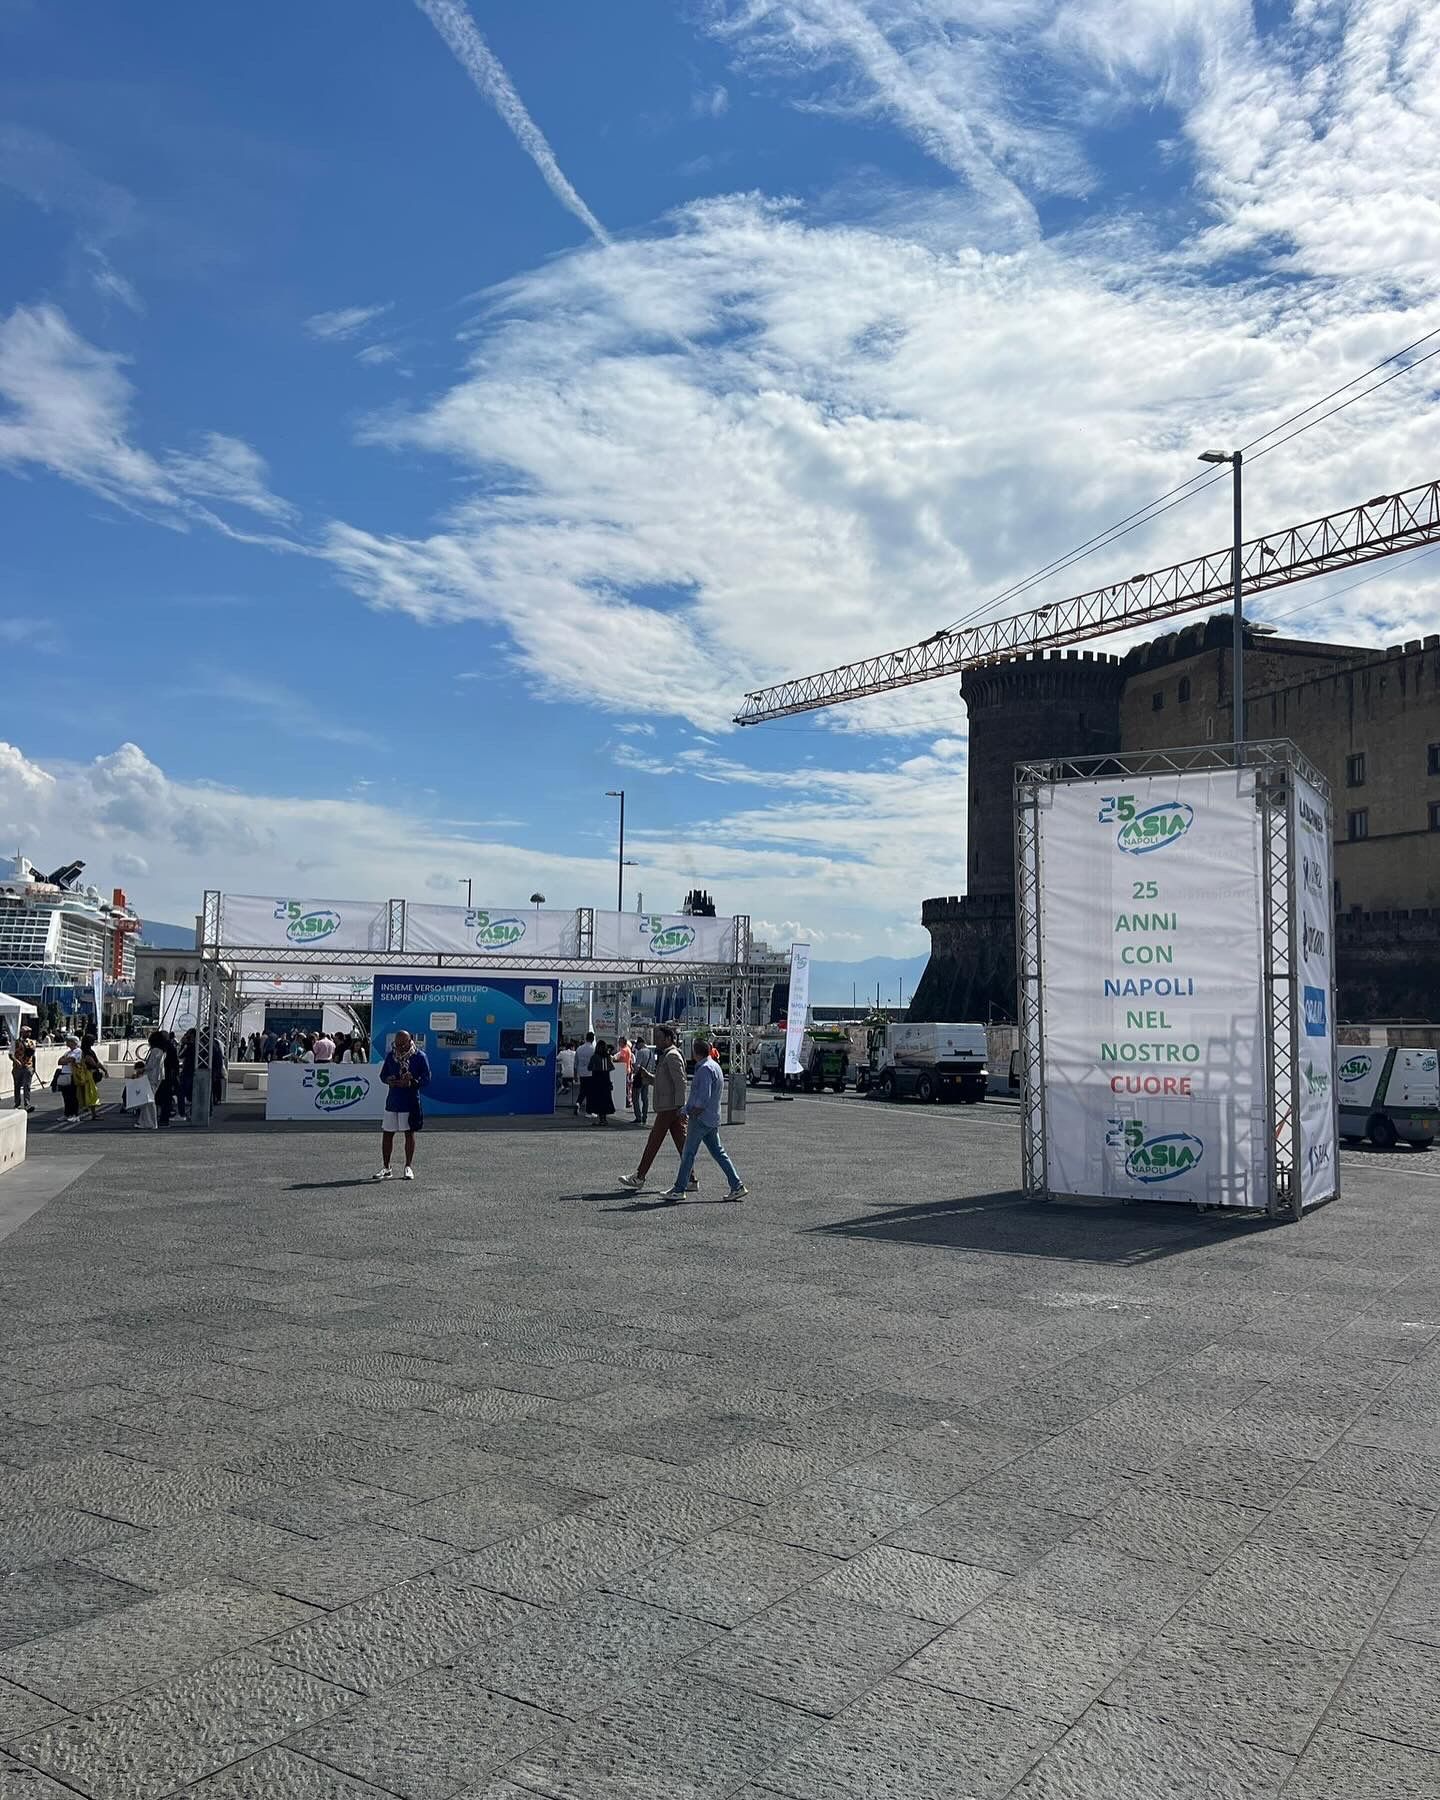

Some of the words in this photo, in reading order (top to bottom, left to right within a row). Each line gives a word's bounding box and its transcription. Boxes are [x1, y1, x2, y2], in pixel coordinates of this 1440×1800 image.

[1098, 795, 1135, 823] 25
[1123, 814, 1186, 837] ASIA
[1124, 837, 1158, 846] NAPOLI
[1132, 880, 1158, 899] 25
[274, 901, 301, 919] 25
[464, 910, 489, 927] 25
[291, 918, 335, 932] ASIA
[639, 916, 662, 933] 25
[1114, 912, 1177, 932] ANNI
[480, 926, 521, 940] ASIA
[653, 932, 690, 946] ASIA
[1121, 945, 1173, 964] CON
[380, 983, 413, 991] INSIEME
[414, 983, 442, 992] VERSO
[456, 985, 489, 993] FUTURO
[1104, 977, 1194, 997] NAPOLI
[380, 993, 412, 1001] SEMPRE
[414, 992, 427, 1001] PIÙ
[428, 994, 478, 1003] SOSTENIBILE
[1126, 1010, 1172, 1029] NEL
[1101, 1043, 1200, 1062] NOSTRO
[1341, 1061, 1367, 1074] ASIA
[302, 1068, 330, 1088] 25
[1110, 1075, 1192, 1096] CUORE
[319, 1085, 364, 1100] ASIA
[1105, 1119, 1144, 1147] 25
[1131, 1144, 1195, 1168] ASIA
[1132, 1165, 1167, 1175] NAPOLI
